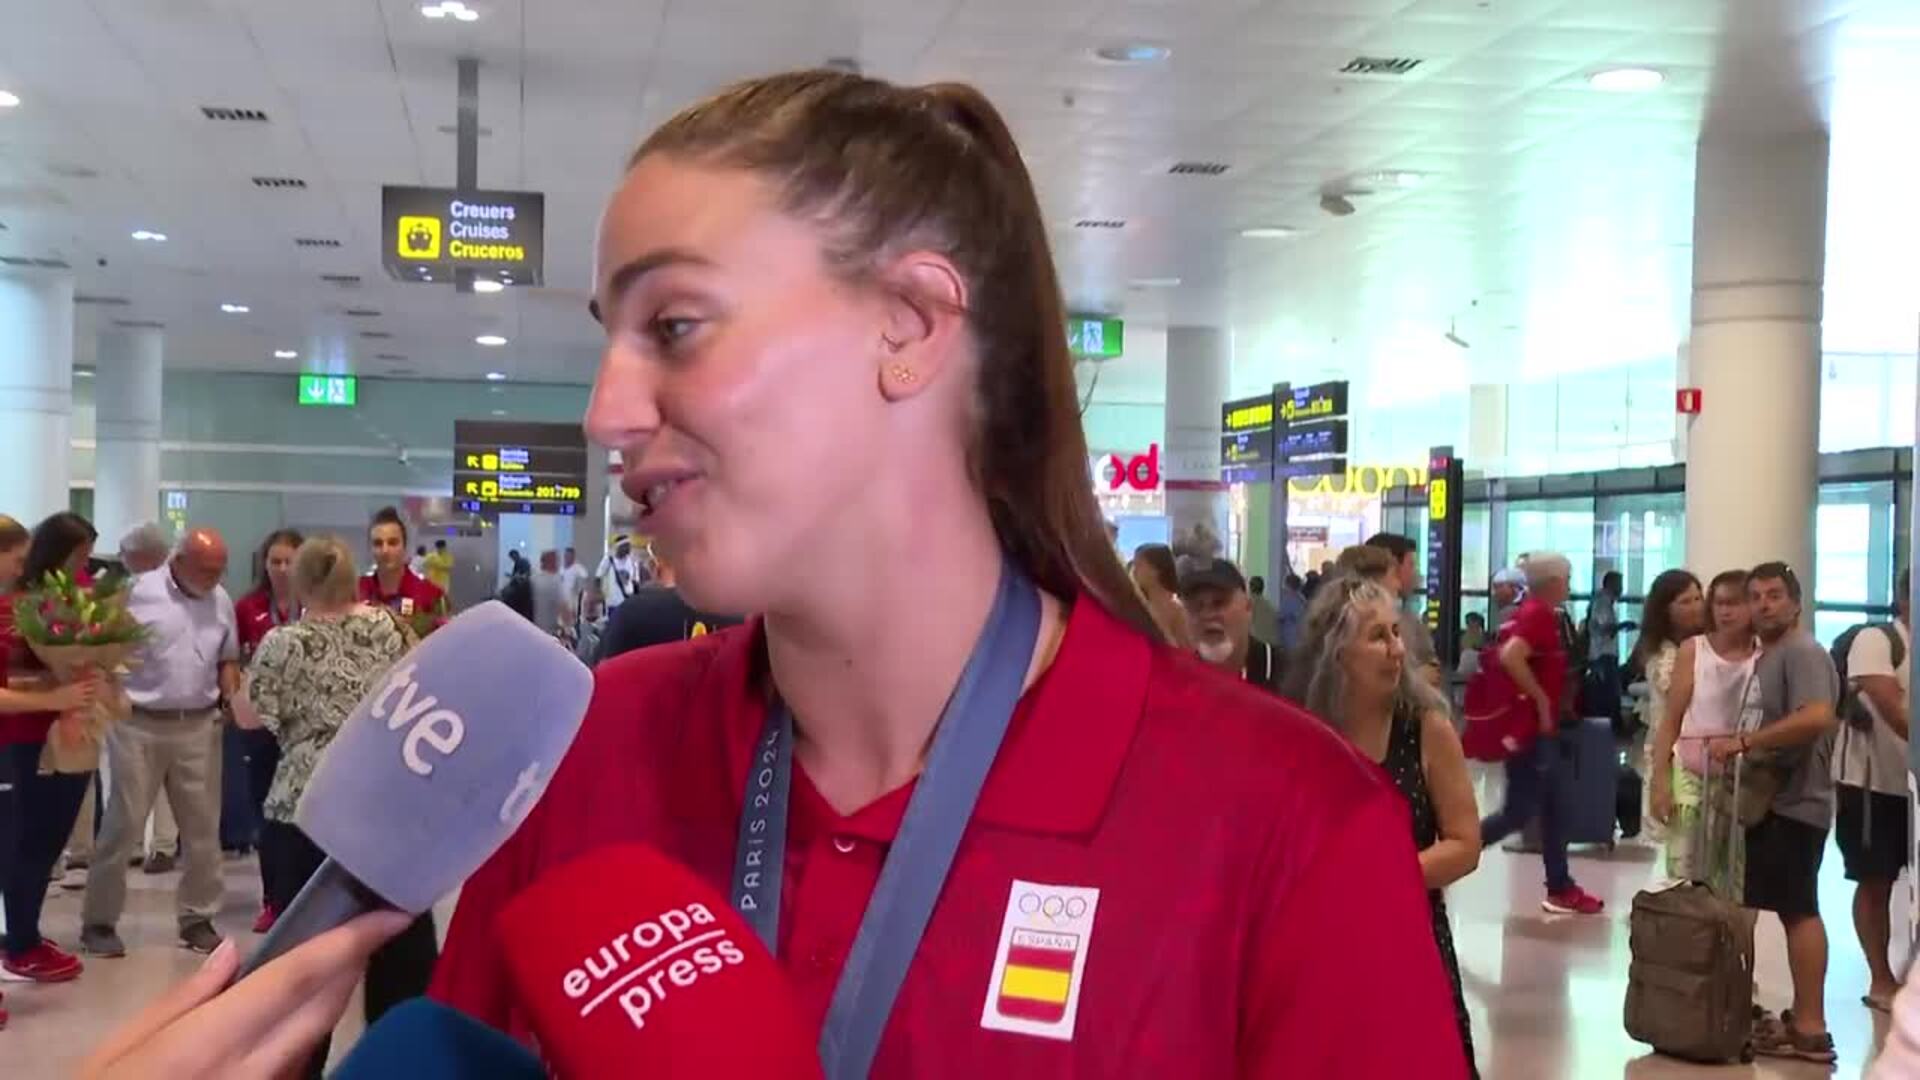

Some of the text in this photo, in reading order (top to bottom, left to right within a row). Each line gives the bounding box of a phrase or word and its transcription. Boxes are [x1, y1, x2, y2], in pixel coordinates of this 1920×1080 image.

[449, 240, 524, 261] Cruceros
[450, 200, 515, 220] Creuers
[450, 221, 509, 239] Cruises
[371, 663, 464, 775] tve
[741, 819, 767, 910] PARIS
[562, 902, 716, 998] europa
[618, 939, 745, 1029] press
